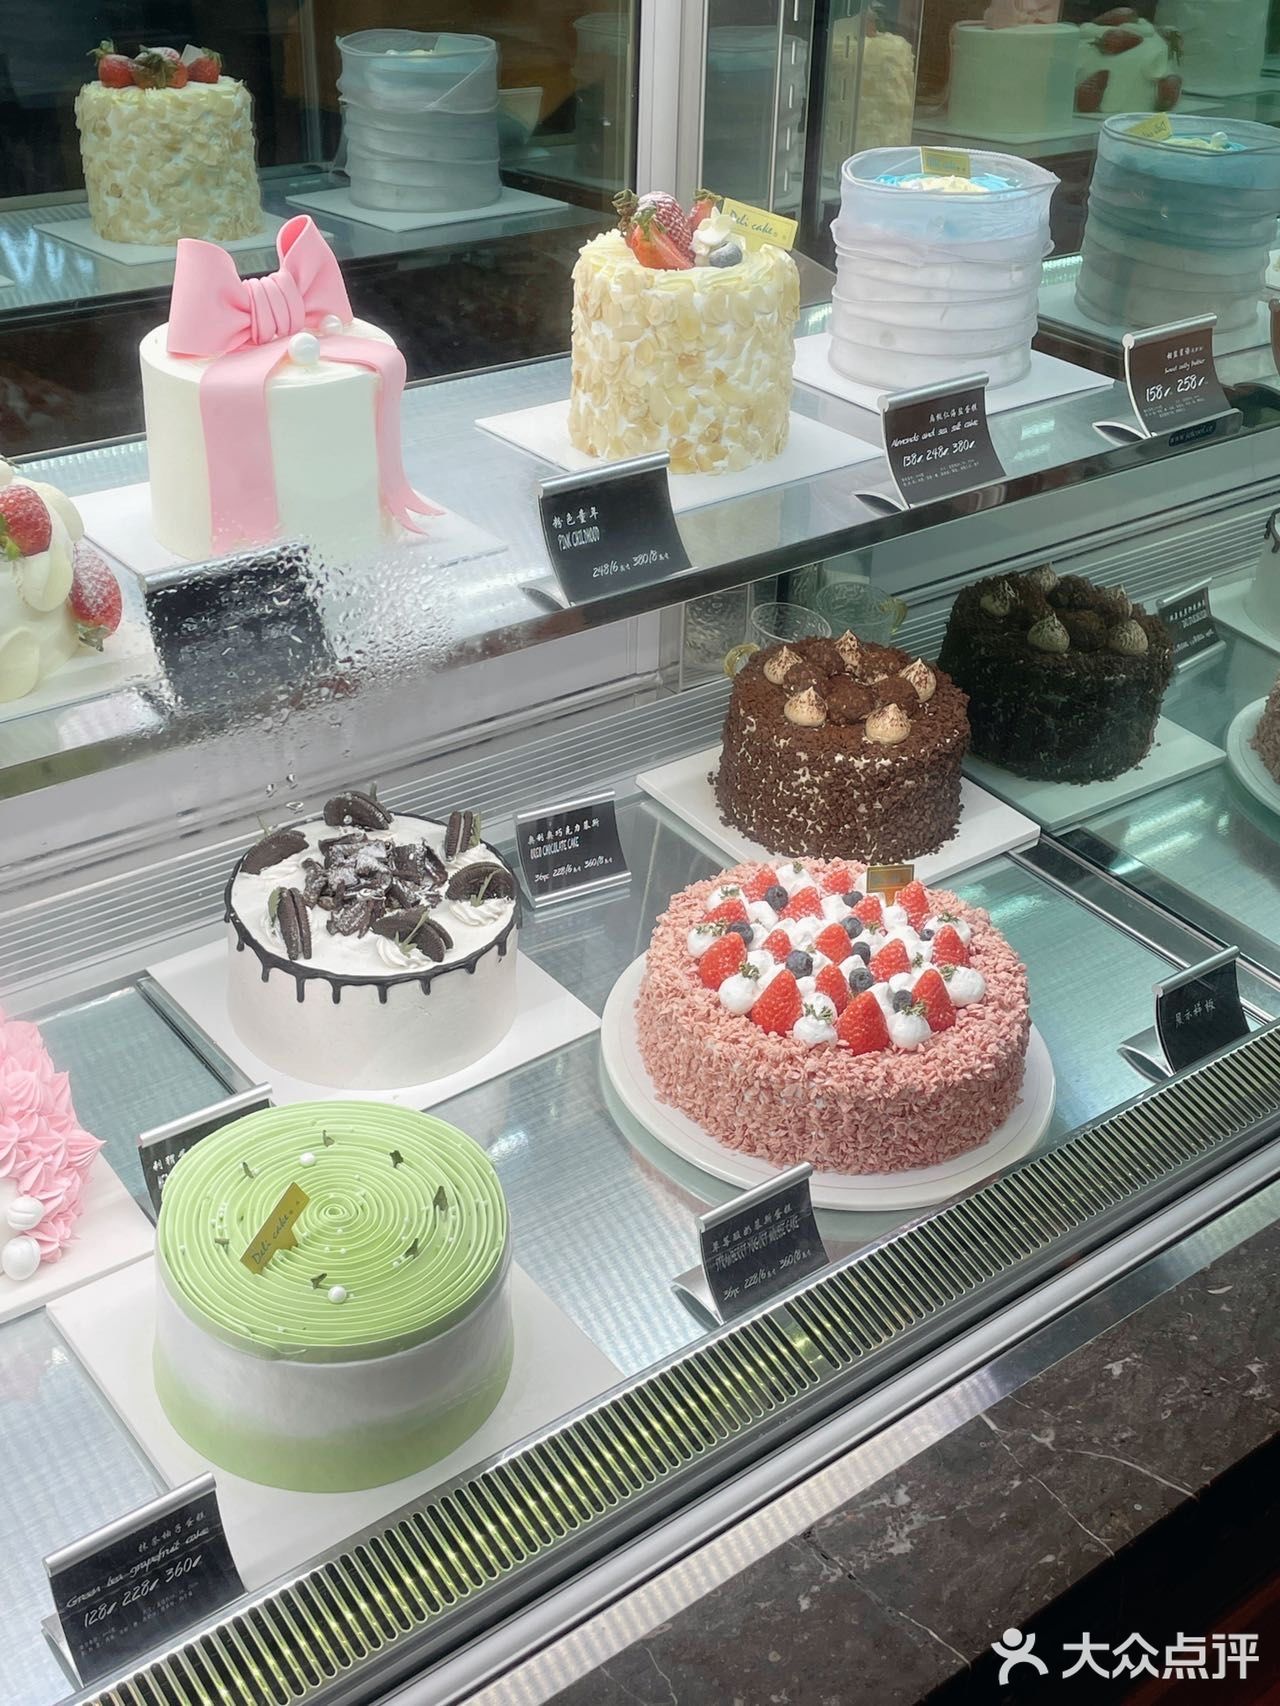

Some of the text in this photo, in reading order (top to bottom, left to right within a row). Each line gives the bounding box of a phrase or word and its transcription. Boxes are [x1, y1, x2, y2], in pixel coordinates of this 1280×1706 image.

[890, 418, 979, 448] Almonds and sea salt cake
[552, 506, 600, 529] 粉色童年
[558, 525, 600, 552] PINK CHILDHOOD
[527, 817, 600, 845] 奥利奥巧克力慕斯
[542, 839, 568, 856] CHOCOLATE
[567, 836, 581, 850] CAKE
[1175, 998, 1217, 1029] 展示样板
[251, 1214, 289, 1265] Deli cake
[711, 1202, 793, 1253] 草莓酸奶慕斯蛋糕
[137, 1511, 206, 1554] 抹茶柚子蛋糕
[66, 1526, 211, 1609] Green tea grapefruit cake
